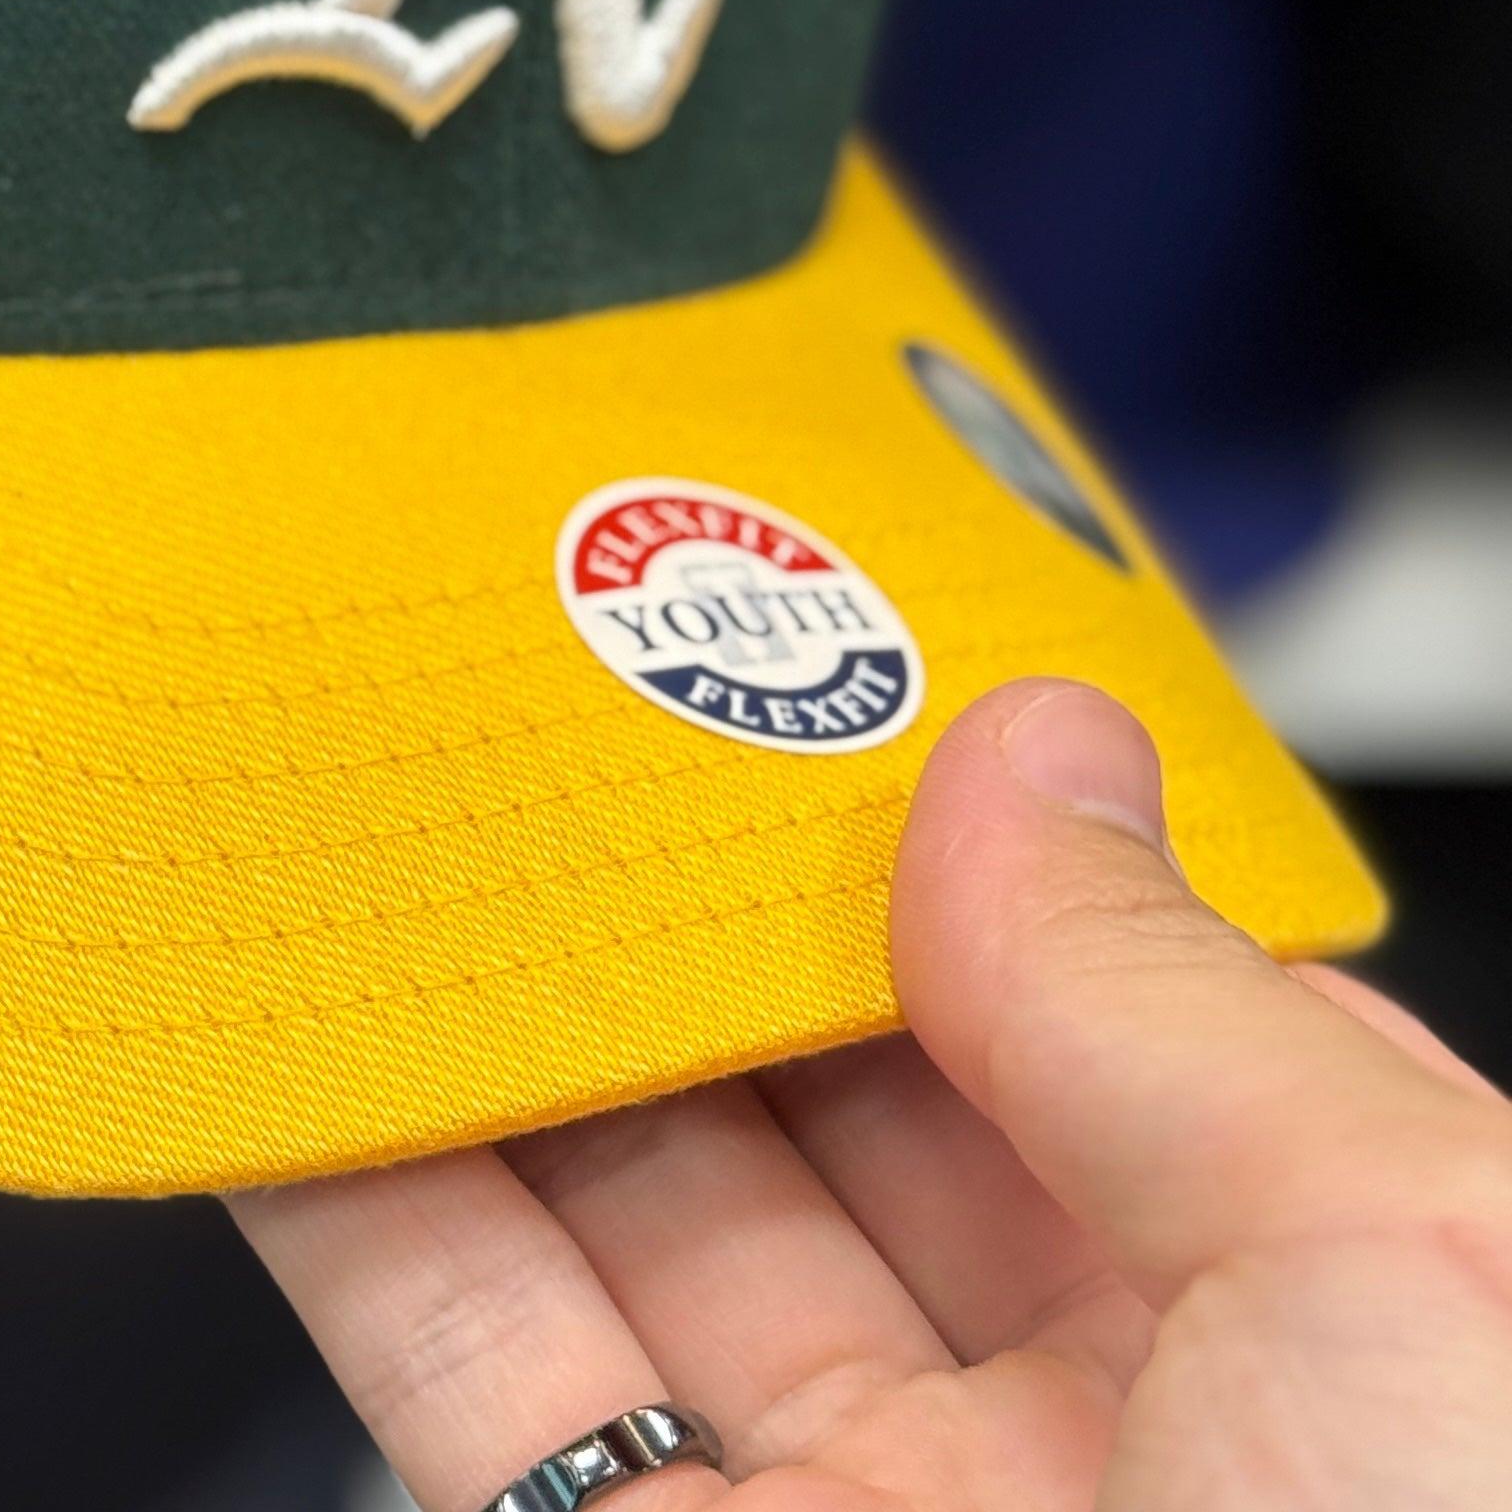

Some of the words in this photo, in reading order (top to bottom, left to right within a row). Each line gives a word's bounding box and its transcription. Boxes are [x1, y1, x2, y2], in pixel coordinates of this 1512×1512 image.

[587, 499, 809, 585] FLEXFIT
[603, 590, 875, 654] YOUTH
[686, 656, 899, 734] FLEXFIT
